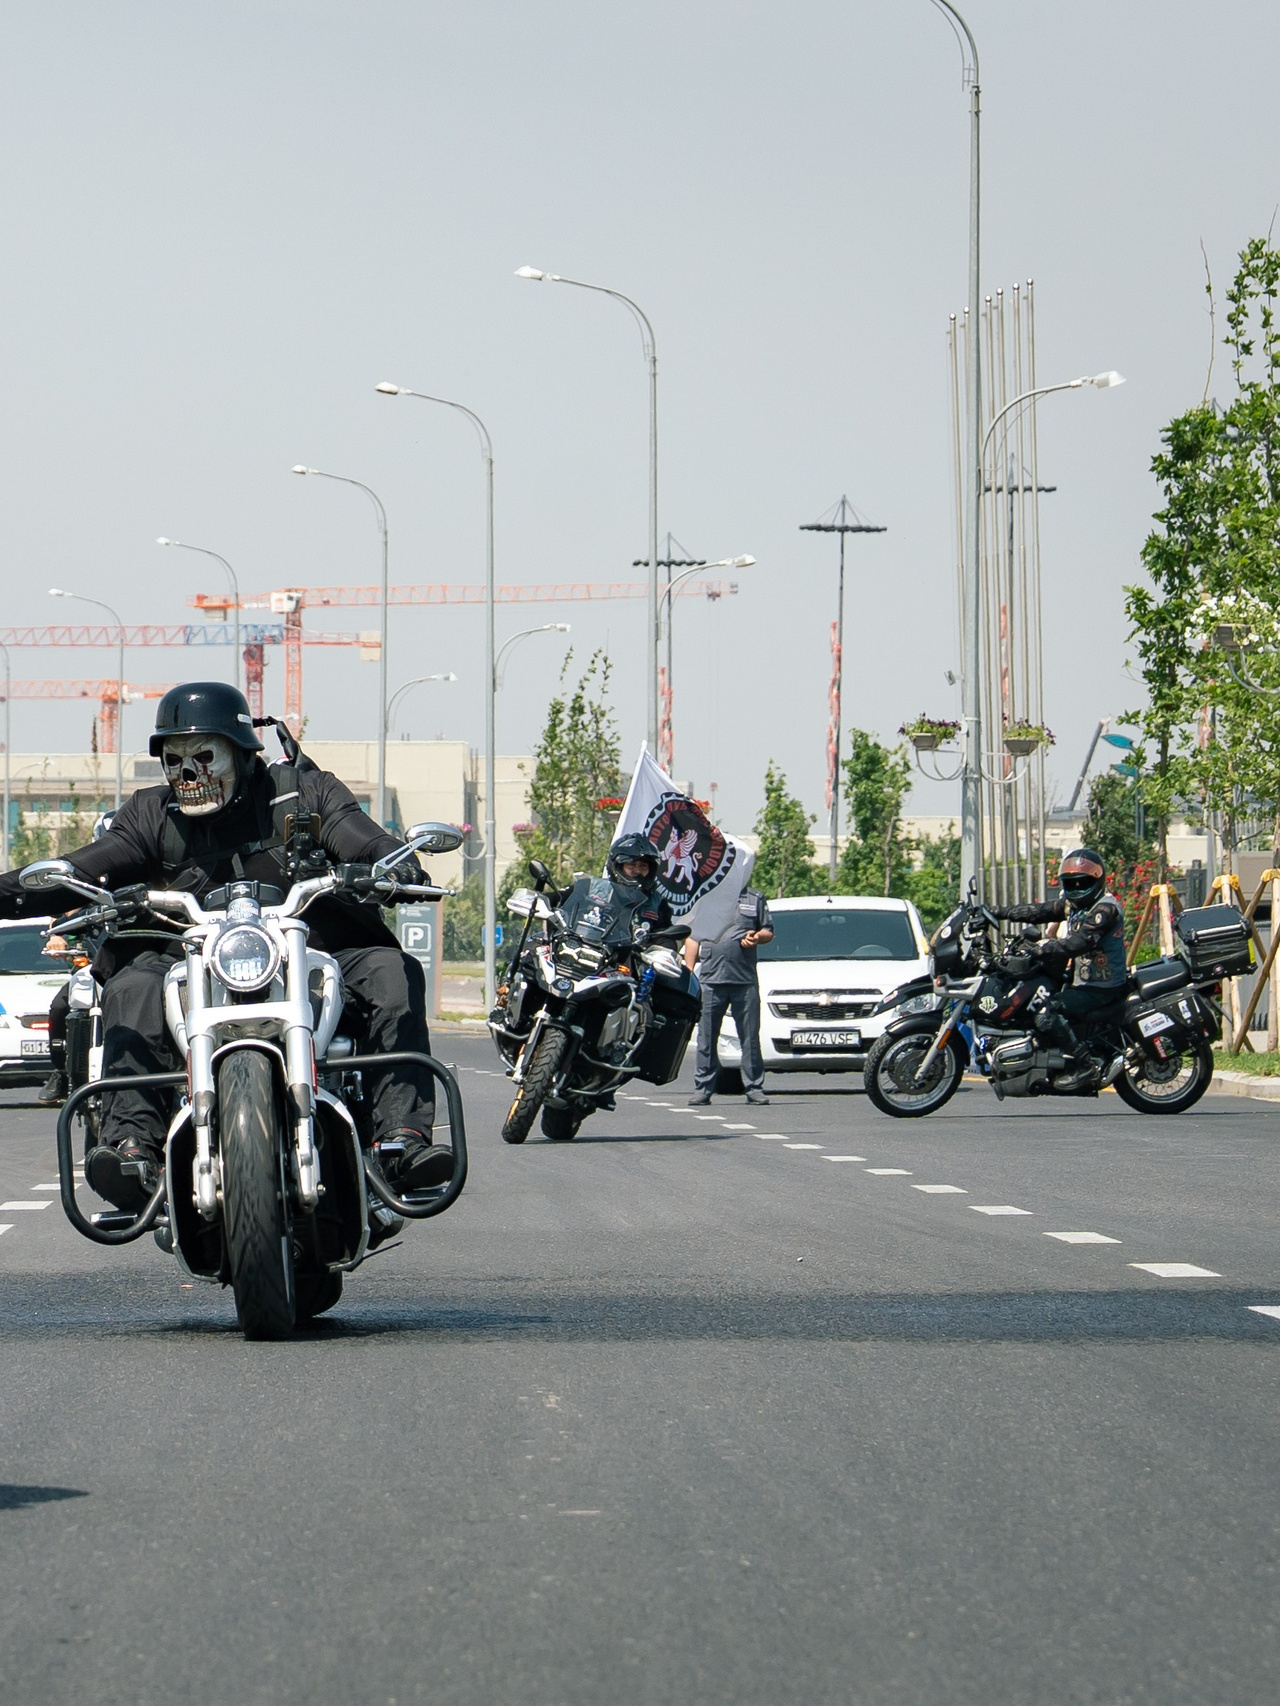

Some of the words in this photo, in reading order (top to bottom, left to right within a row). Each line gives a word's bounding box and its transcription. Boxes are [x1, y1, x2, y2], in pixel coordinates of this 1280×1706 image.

[408, 927, 424, 947] P
[1027, 985, 1051, 1012] TSR
[806, 1033, 827, 1045] 476
